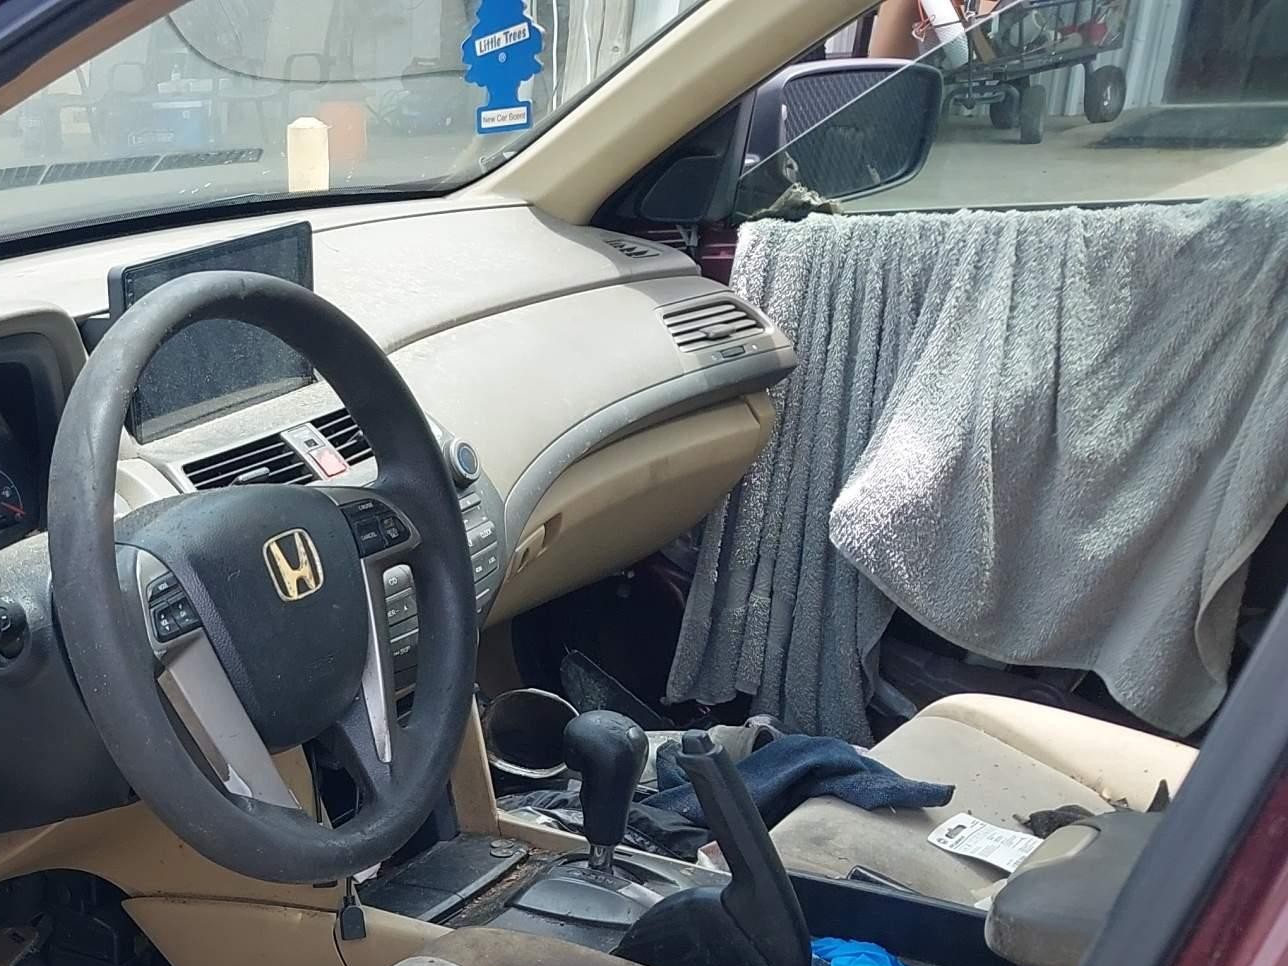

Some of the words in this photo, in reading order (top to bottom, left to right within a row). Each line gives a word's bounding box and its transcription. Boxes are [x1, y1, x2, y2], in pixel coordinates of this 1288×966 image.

[478, 36, 501, 53] Little
[504, 27, 527, 44] Trees
[482, 115, 496, 124] New
[496, 113, 508, 123] Car
